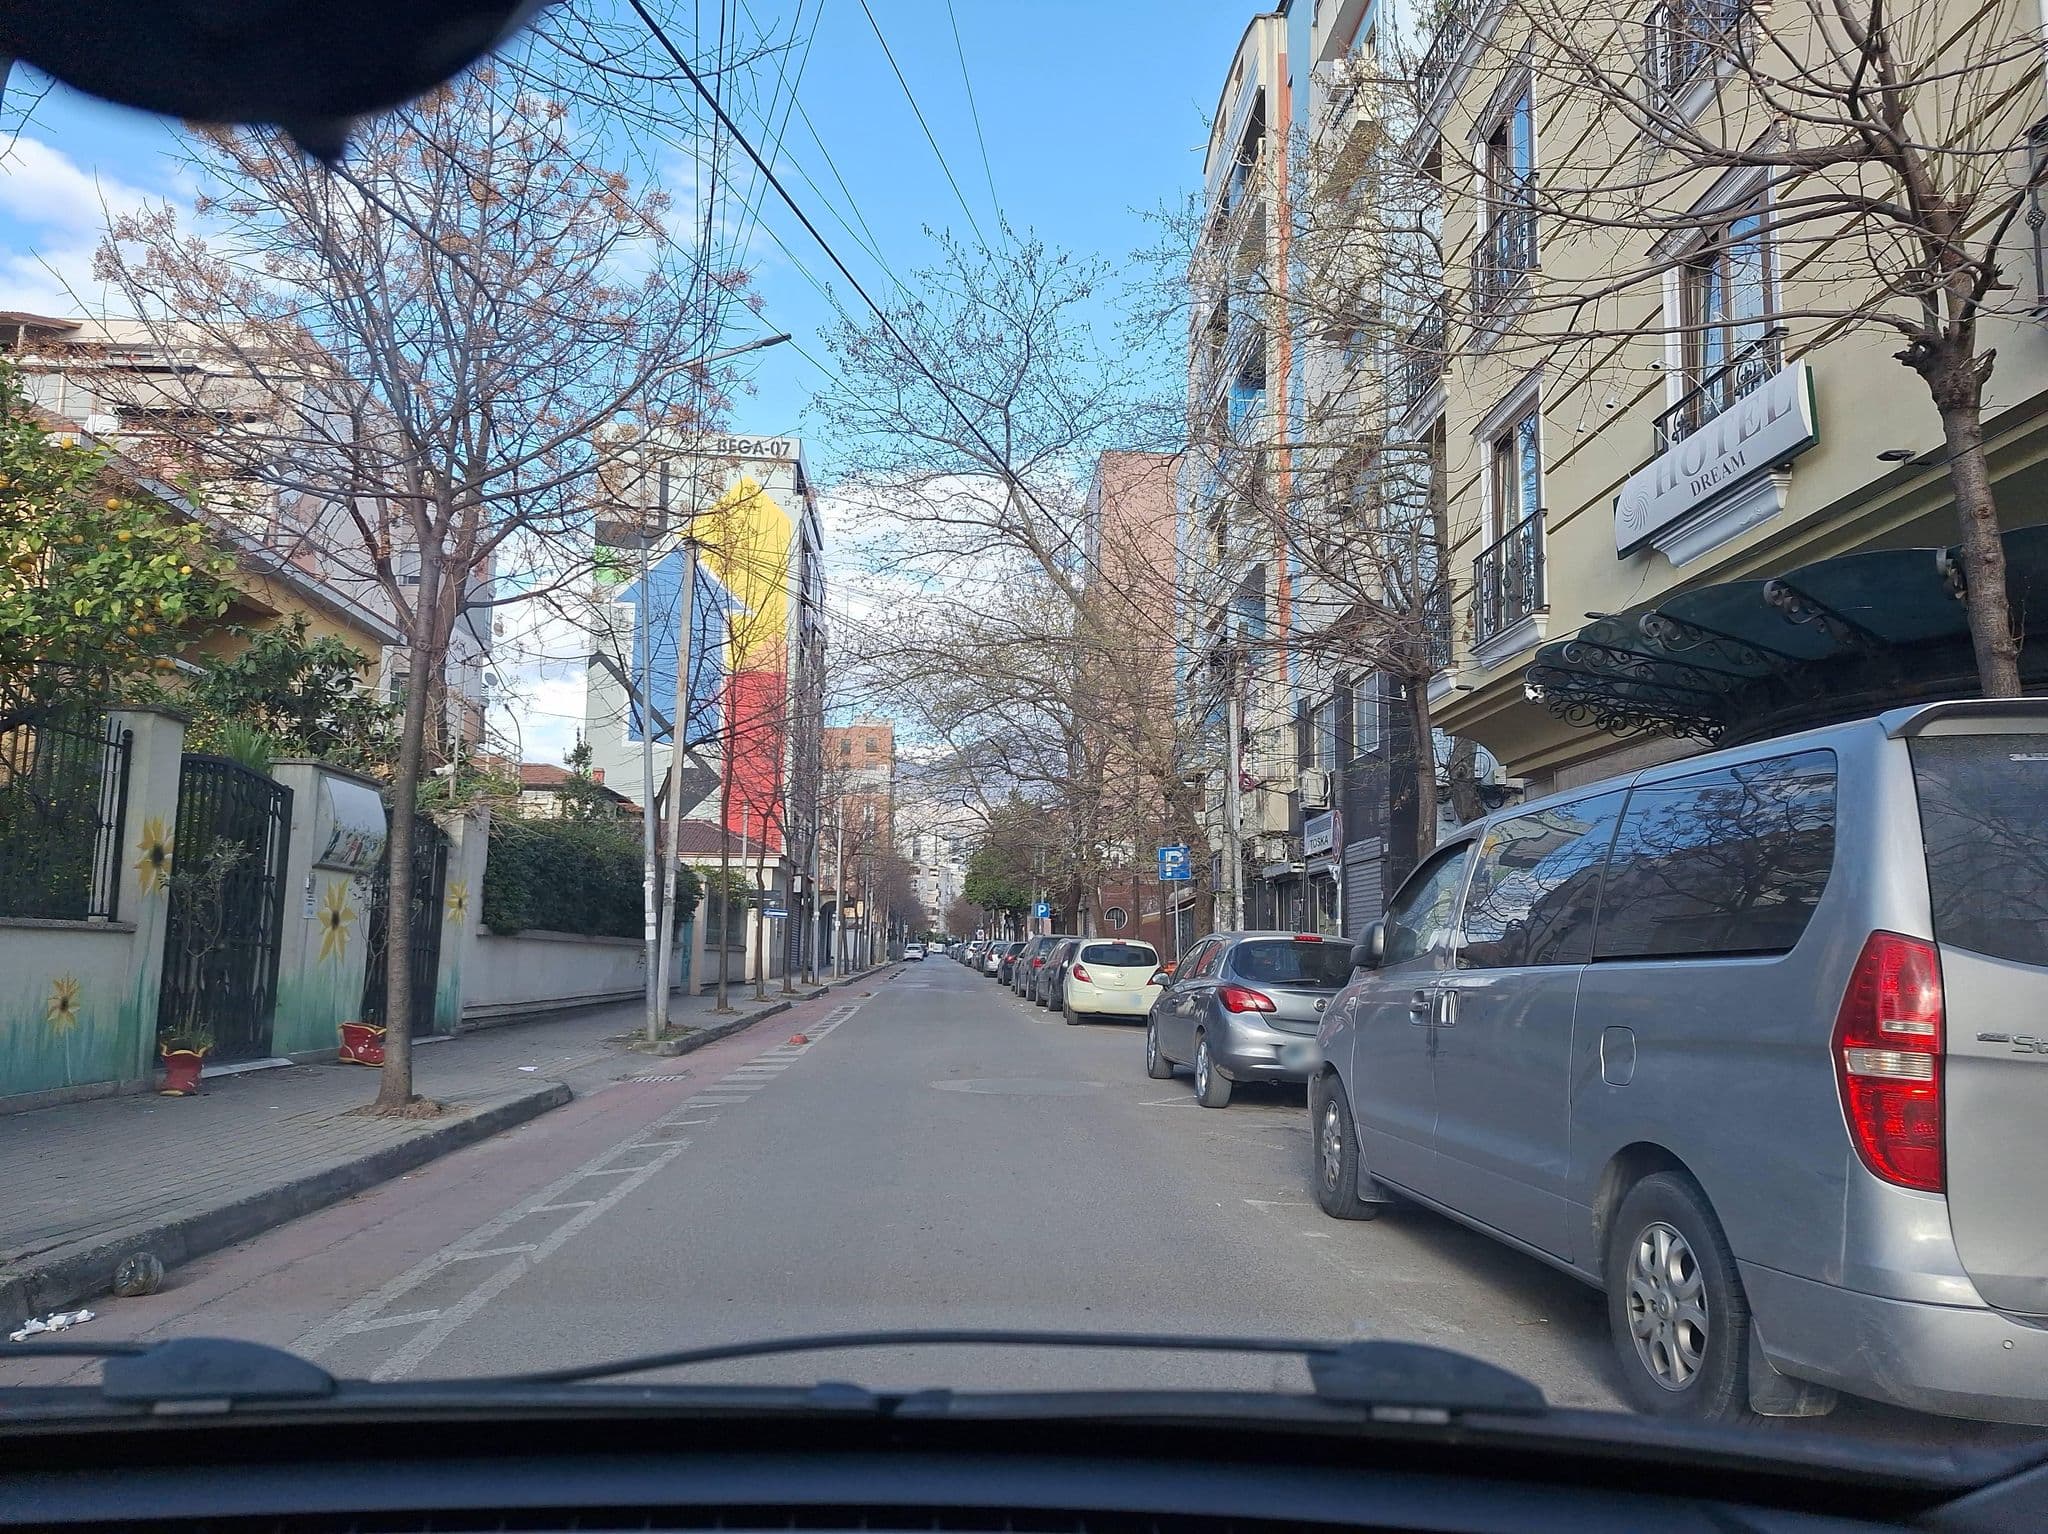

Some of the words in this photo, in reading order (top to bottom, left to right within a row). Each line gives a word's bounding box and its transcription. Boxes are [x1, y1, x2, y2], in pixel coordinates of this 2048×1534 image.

[718, 438, 791, 456] BEGA-07
[1654, 383, 1792, 500] HOTEL
[1690, 450, 1747, 497] DREAM
[1310, 834, 1329, 849] TOSKA
[1166, 850, 1184, 876] P
[1038, 905, 1048, 917] P
